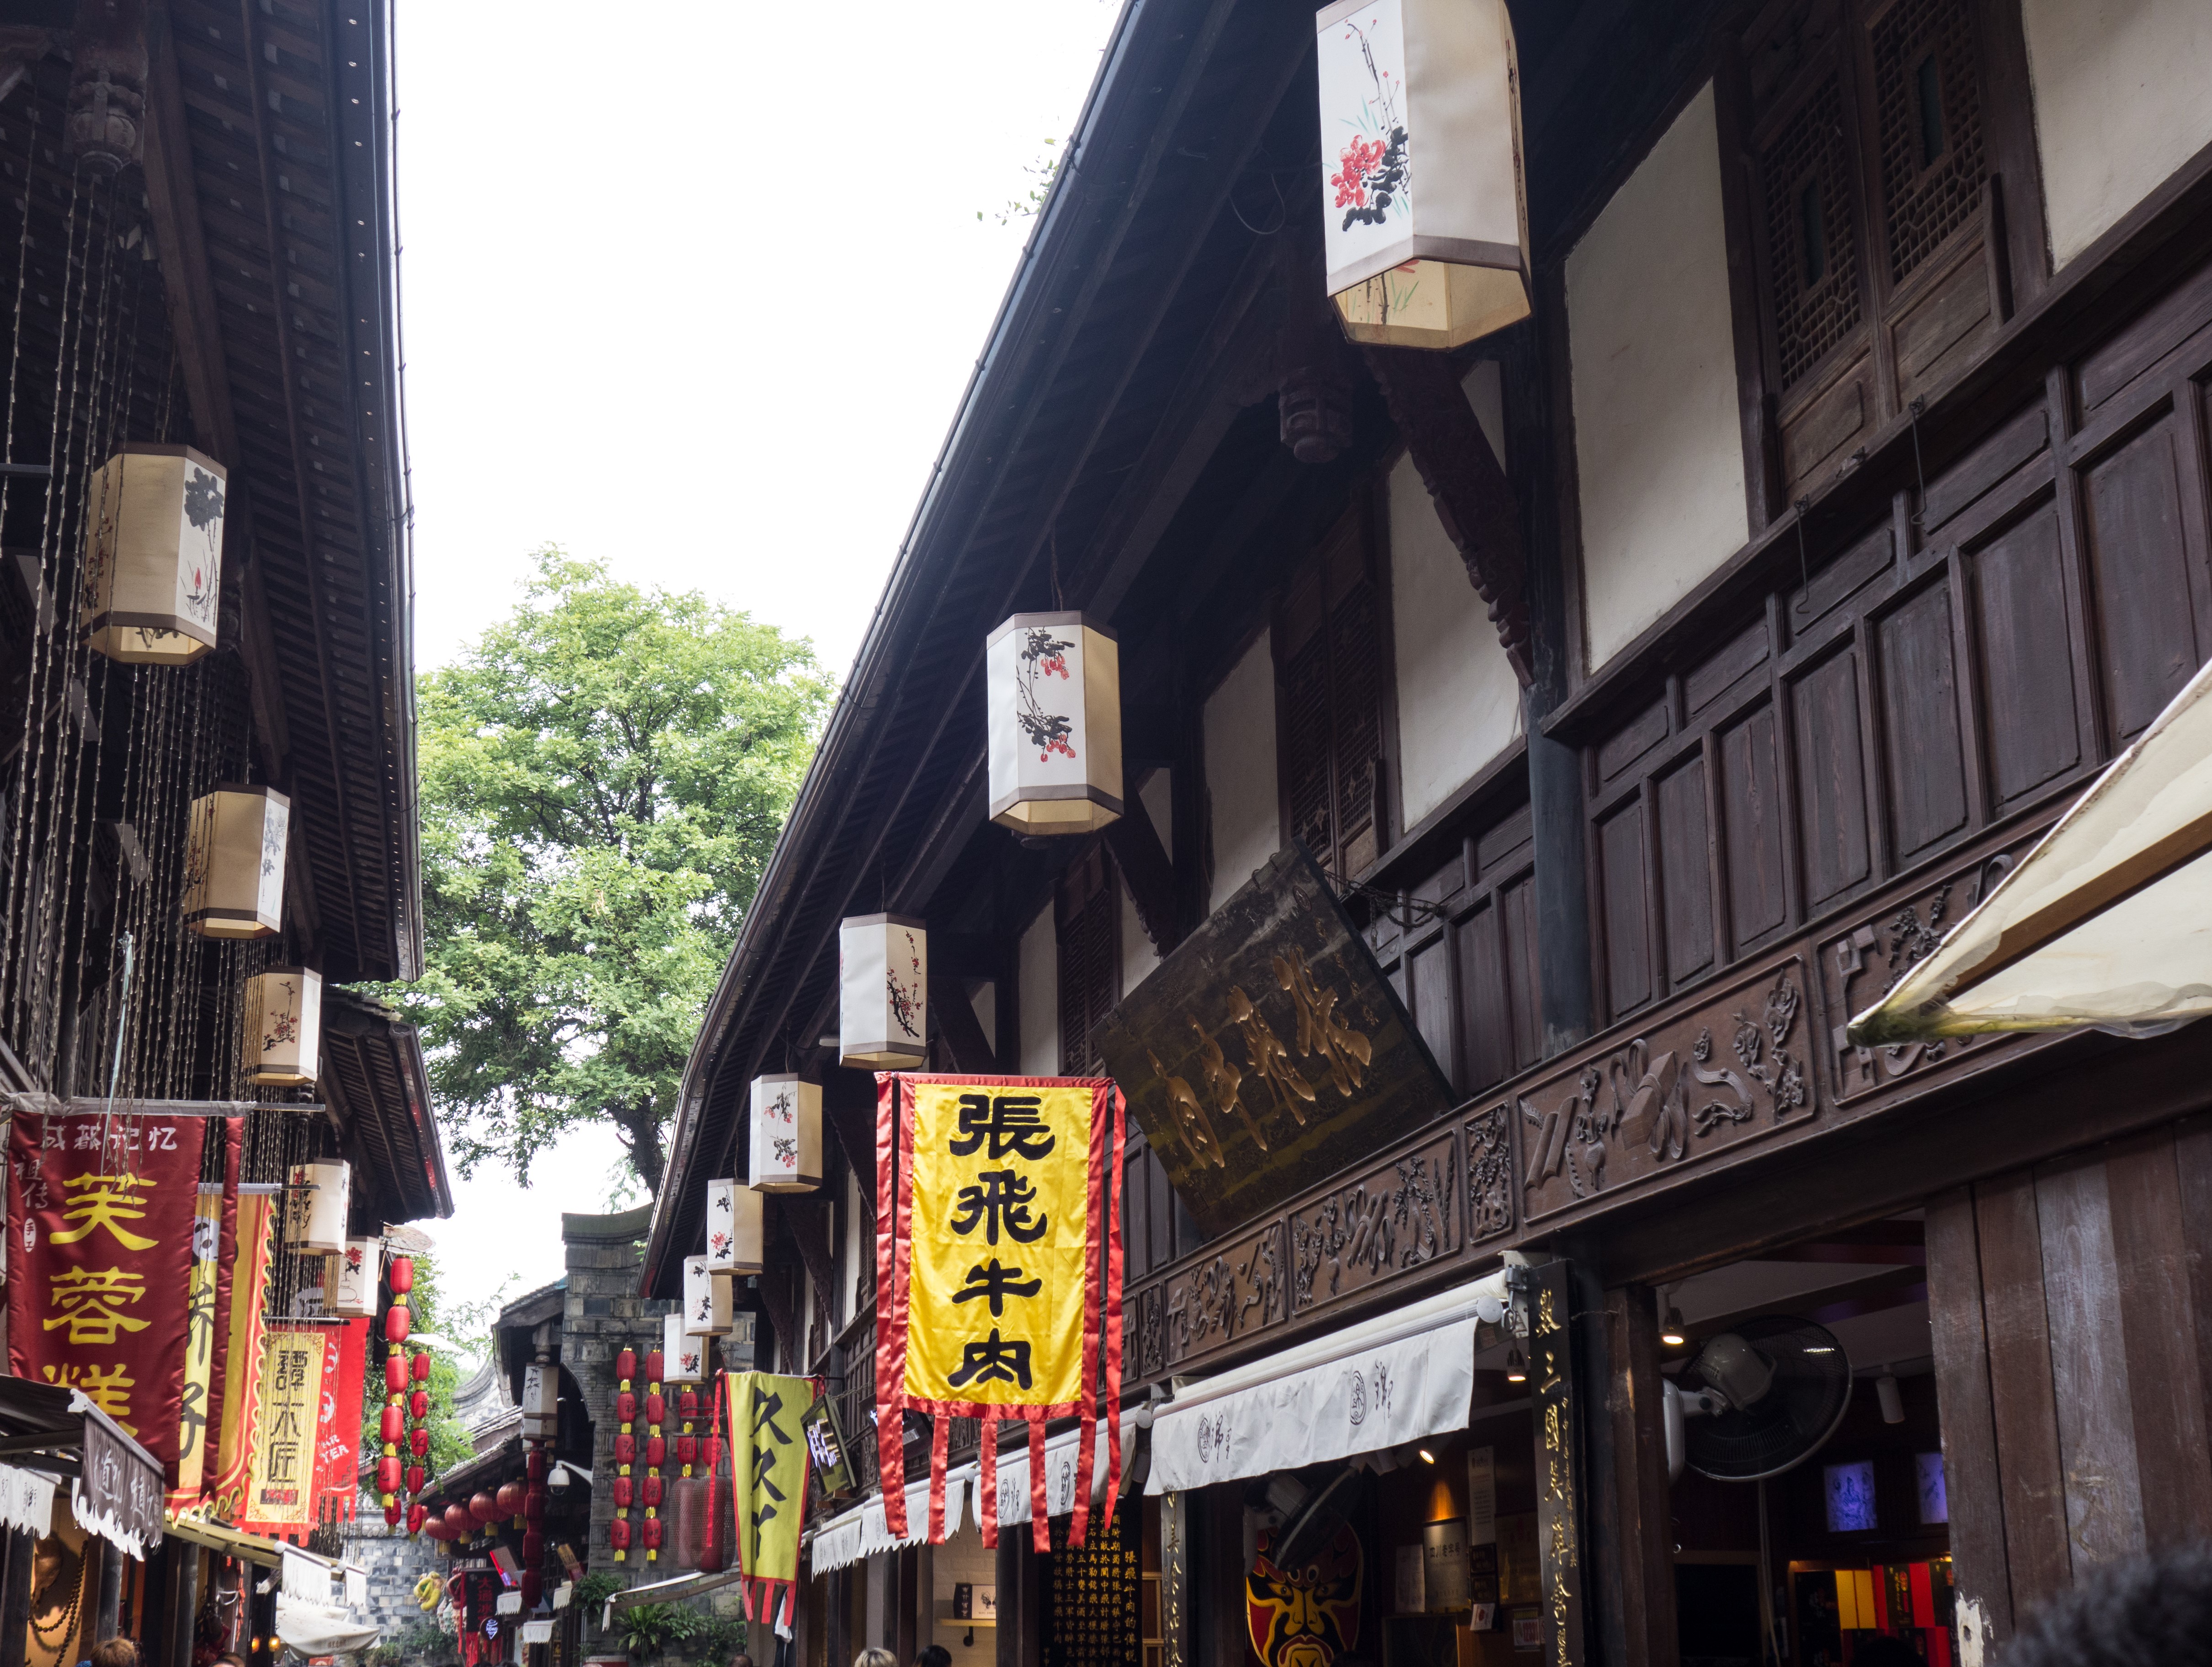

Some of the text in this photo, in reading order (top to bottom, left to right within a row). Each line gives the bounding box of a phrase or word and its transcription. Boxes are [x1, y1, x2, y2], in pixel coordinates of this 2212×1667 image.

[40, 1124, 177, 1151] 成都记忆
[14, 1154, 48, 1209] 祖传
[947, 1094, 1055, 1391] 張飛牛肉
[319, 1444, 349, 1465] TEA
[750, 1386, 794, 1560] 久久丫
